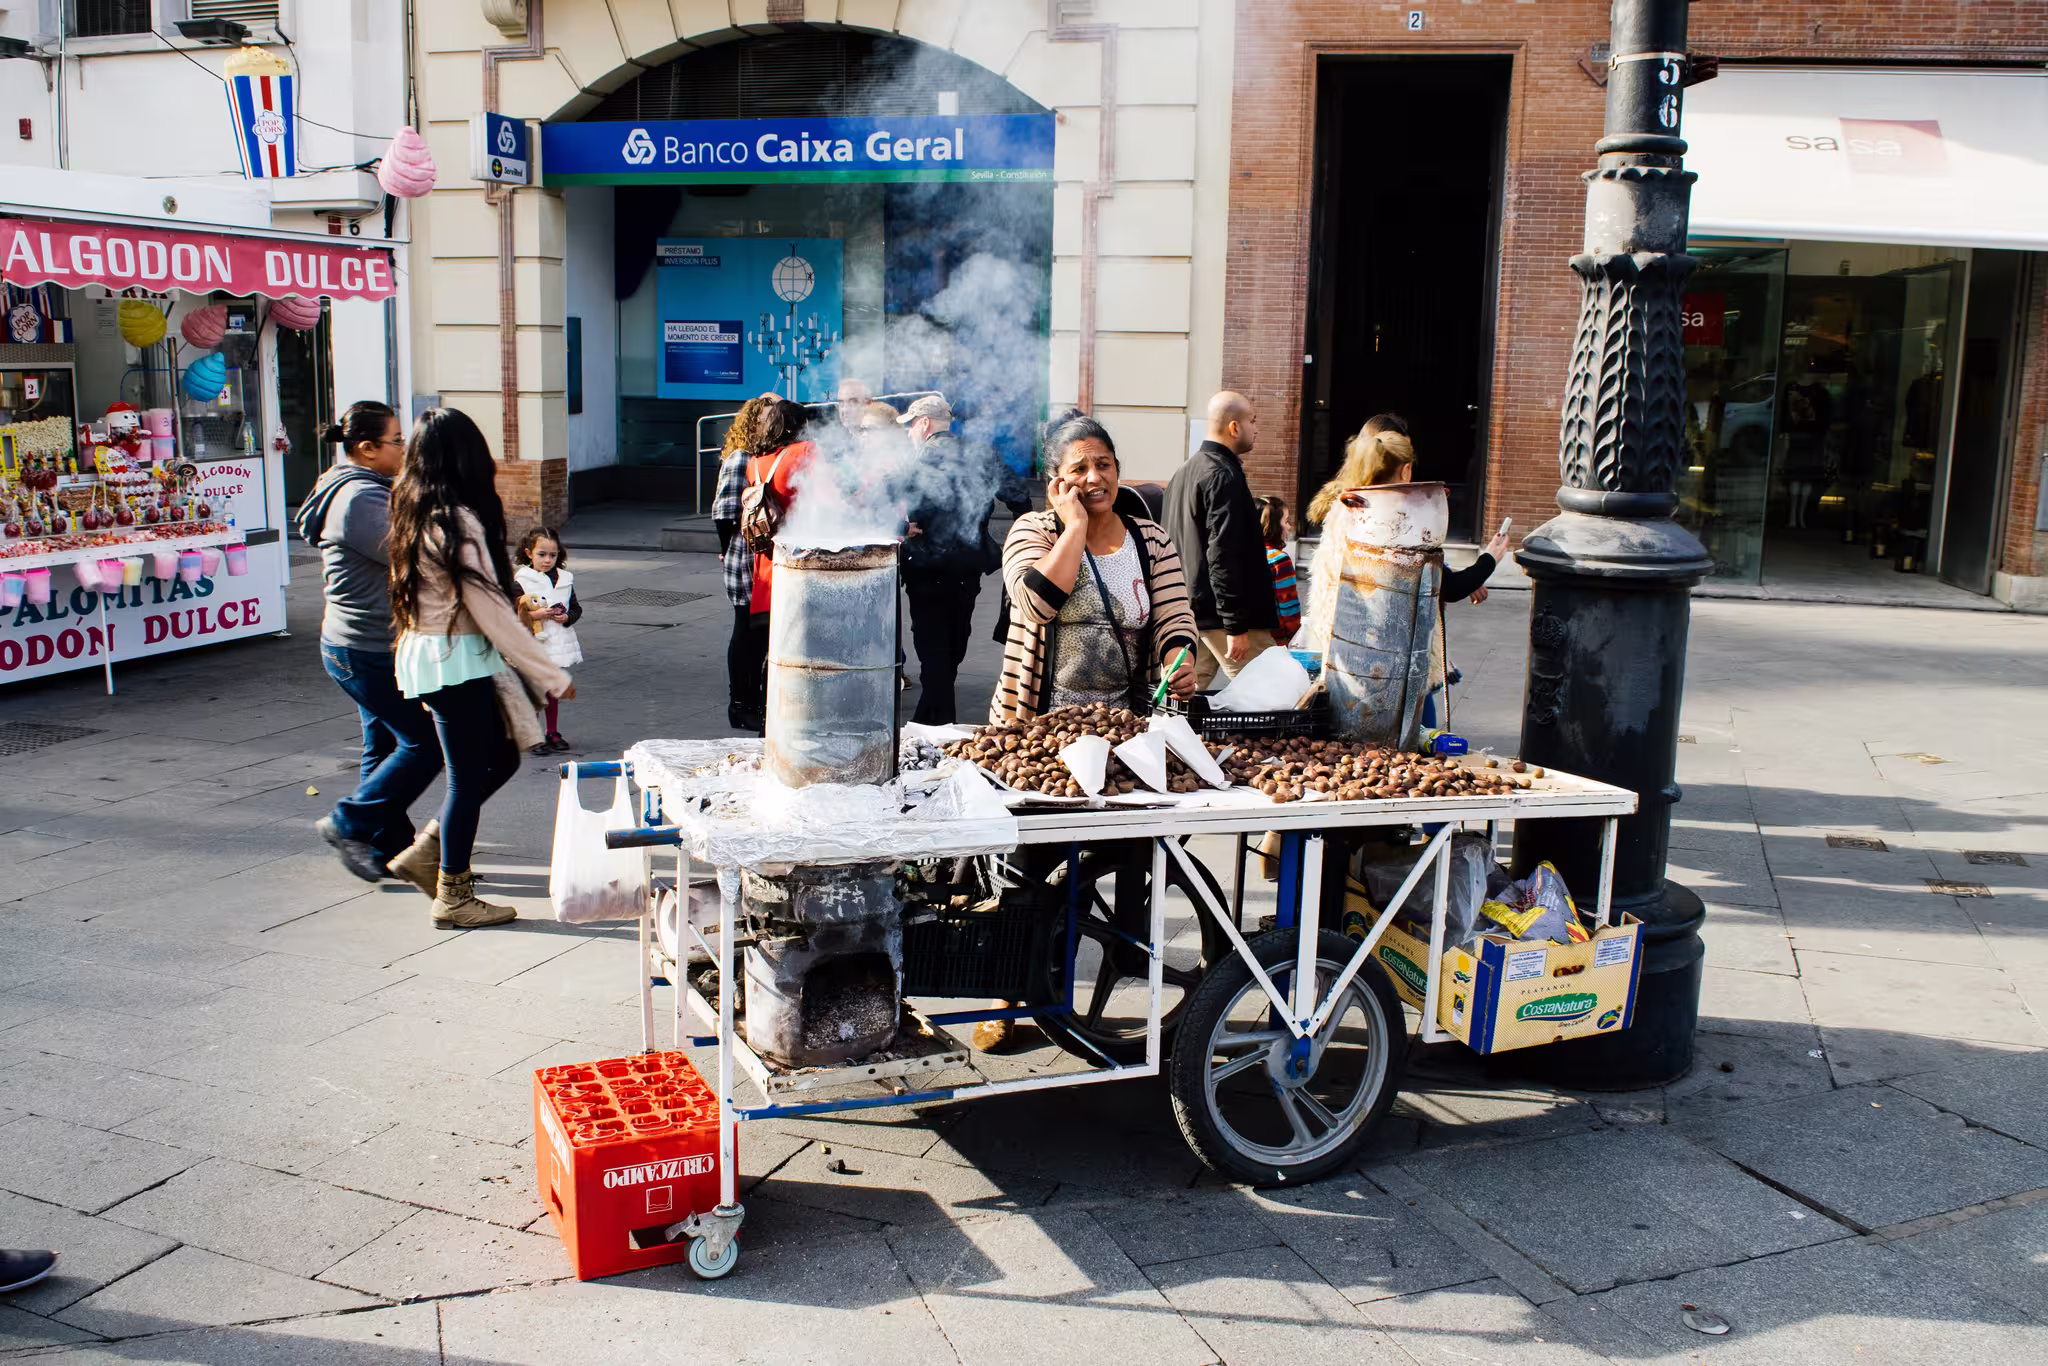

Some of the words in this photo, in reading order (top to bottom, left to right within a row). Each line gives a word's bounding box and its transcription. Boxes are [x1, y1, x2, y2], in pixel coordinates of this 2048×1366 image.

[1411, 13, 1420, 28] 2
[262, 119, 280, 127] POP
[664, 136, 749, 164] Banco
[756, 132, 854, 163] Caixa
[866, 127, 964, 162] Geral
[971, 170, 994, 180] Sevilla
[6, 230, 233, 284] ALGODON
[265, 250, 390, 292] DULCE
[701, 257, 718, 265] PLUS
[15, 310, 31, 327] POP
[16, 315, 39, 337] CORN
[678, 325, 708, 333] LLEGADO
[667, 333, 700, 341] MOMENTO
[711, 334, 737, 342] CRECER
[205, 484, 244, 497] DULCE
[0, 572, 215, 628] ALOMITAS
[143, 597, 261, 645] DULCE
[603, 1155, 715, 1189] CRUZCAMPO
